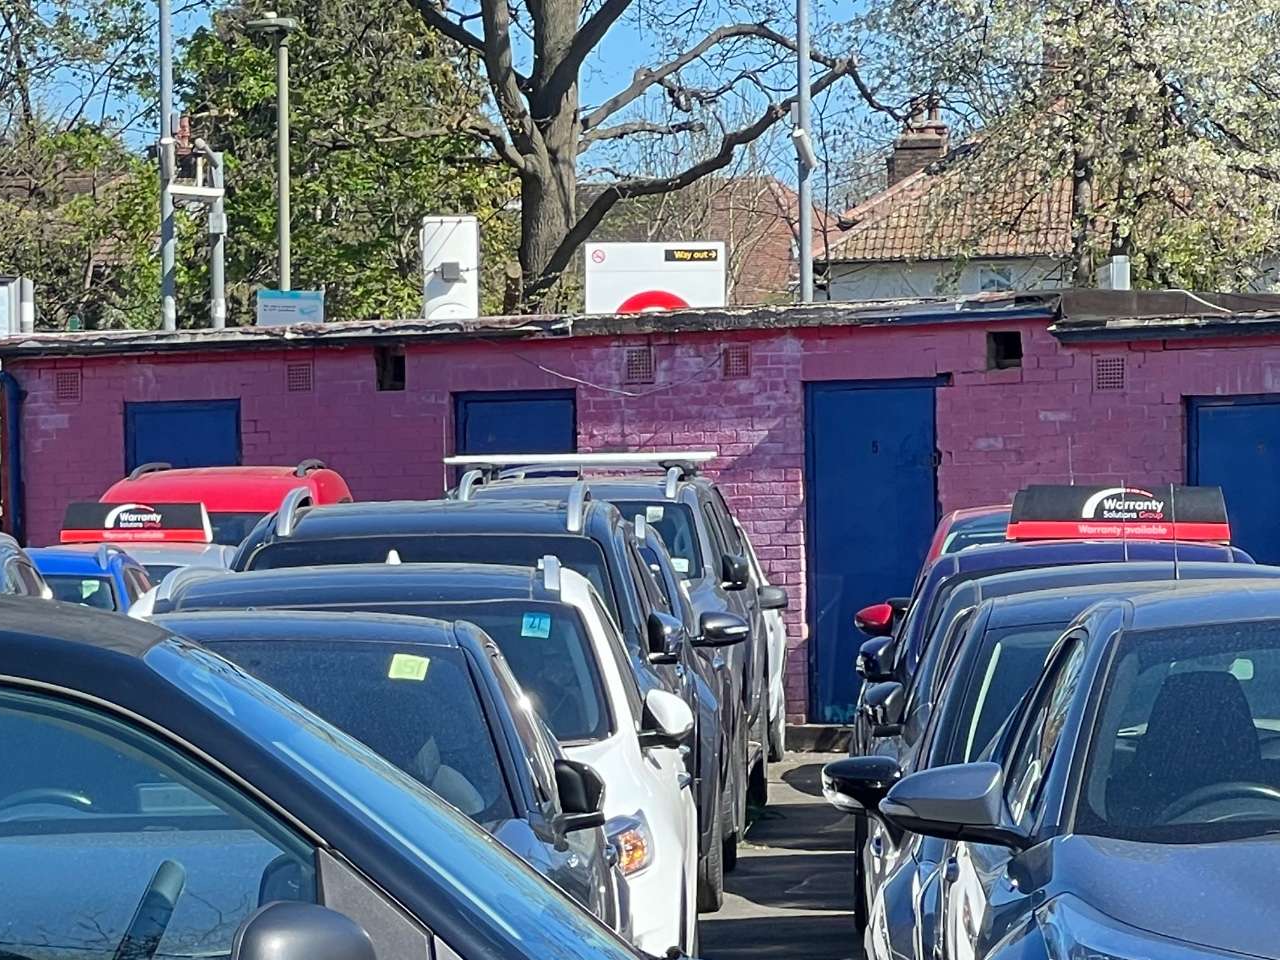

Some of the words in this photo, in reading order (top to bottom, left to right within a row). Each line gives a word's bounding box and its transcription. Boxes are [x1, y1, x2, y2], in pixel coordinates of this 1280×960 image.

[673, 250, 691, 260] Way
[693, 250, 708, 259] out
[1103, 498, 1164, 512] Warranty
[119, 512, 162, 523] Warranty
[1103, 510, 1137, 519] Solutions
[1138, 510, 1164, 520] Group
[1078, 524, 1122, 536] Warranty
[1124, 524, 1168, 535] available
